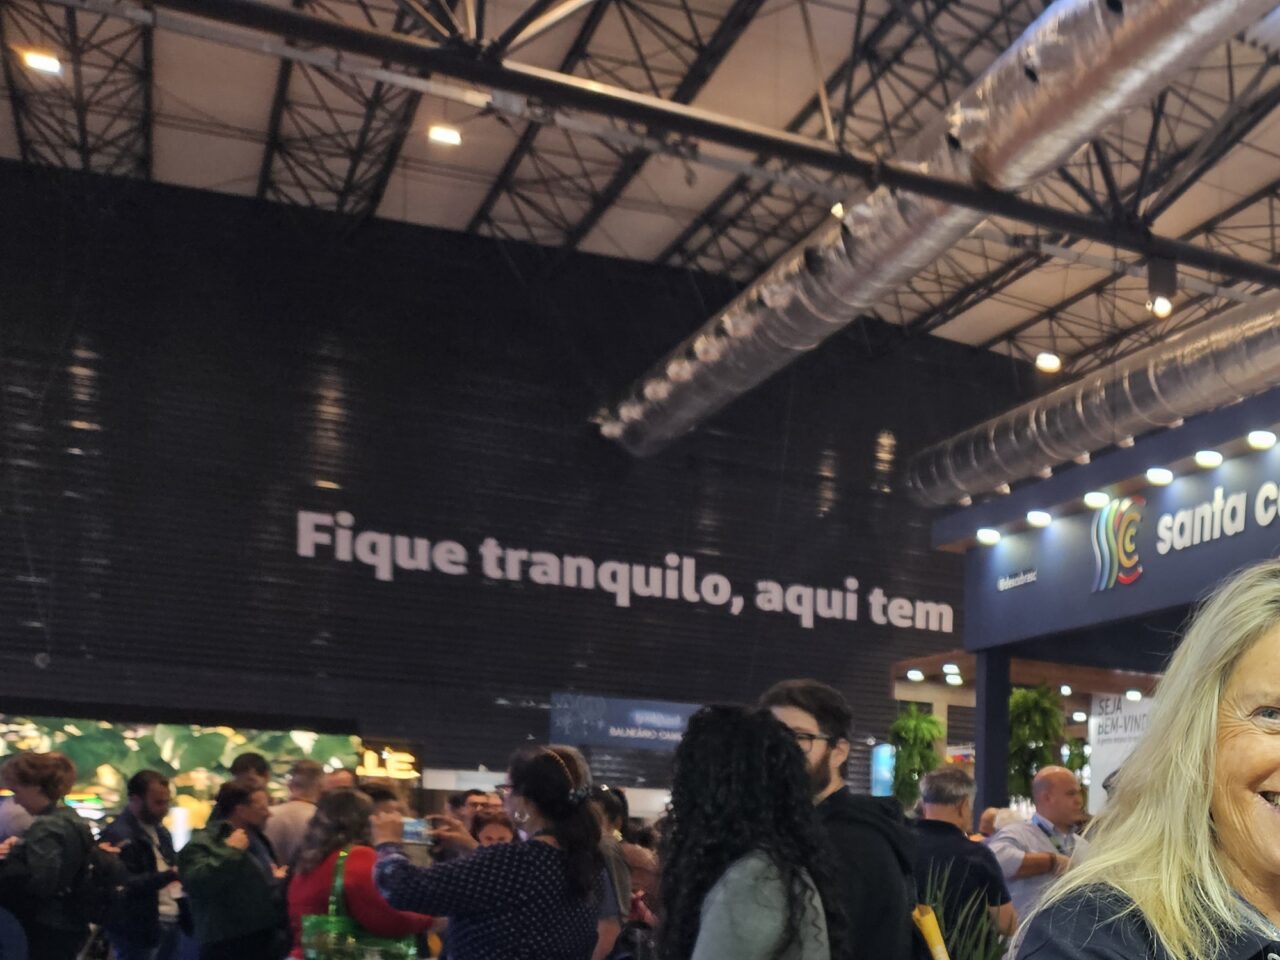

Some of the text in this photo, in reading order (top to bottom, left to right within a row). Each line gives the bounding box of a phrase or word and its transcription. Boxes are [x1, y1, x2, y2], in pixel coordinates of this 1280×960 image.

[1156, 486, 1247, 556] santa
[297, 510, 954, 633] Fique tranquilo, aqui tem
[1098, 696, 1123, 716] SEJA
